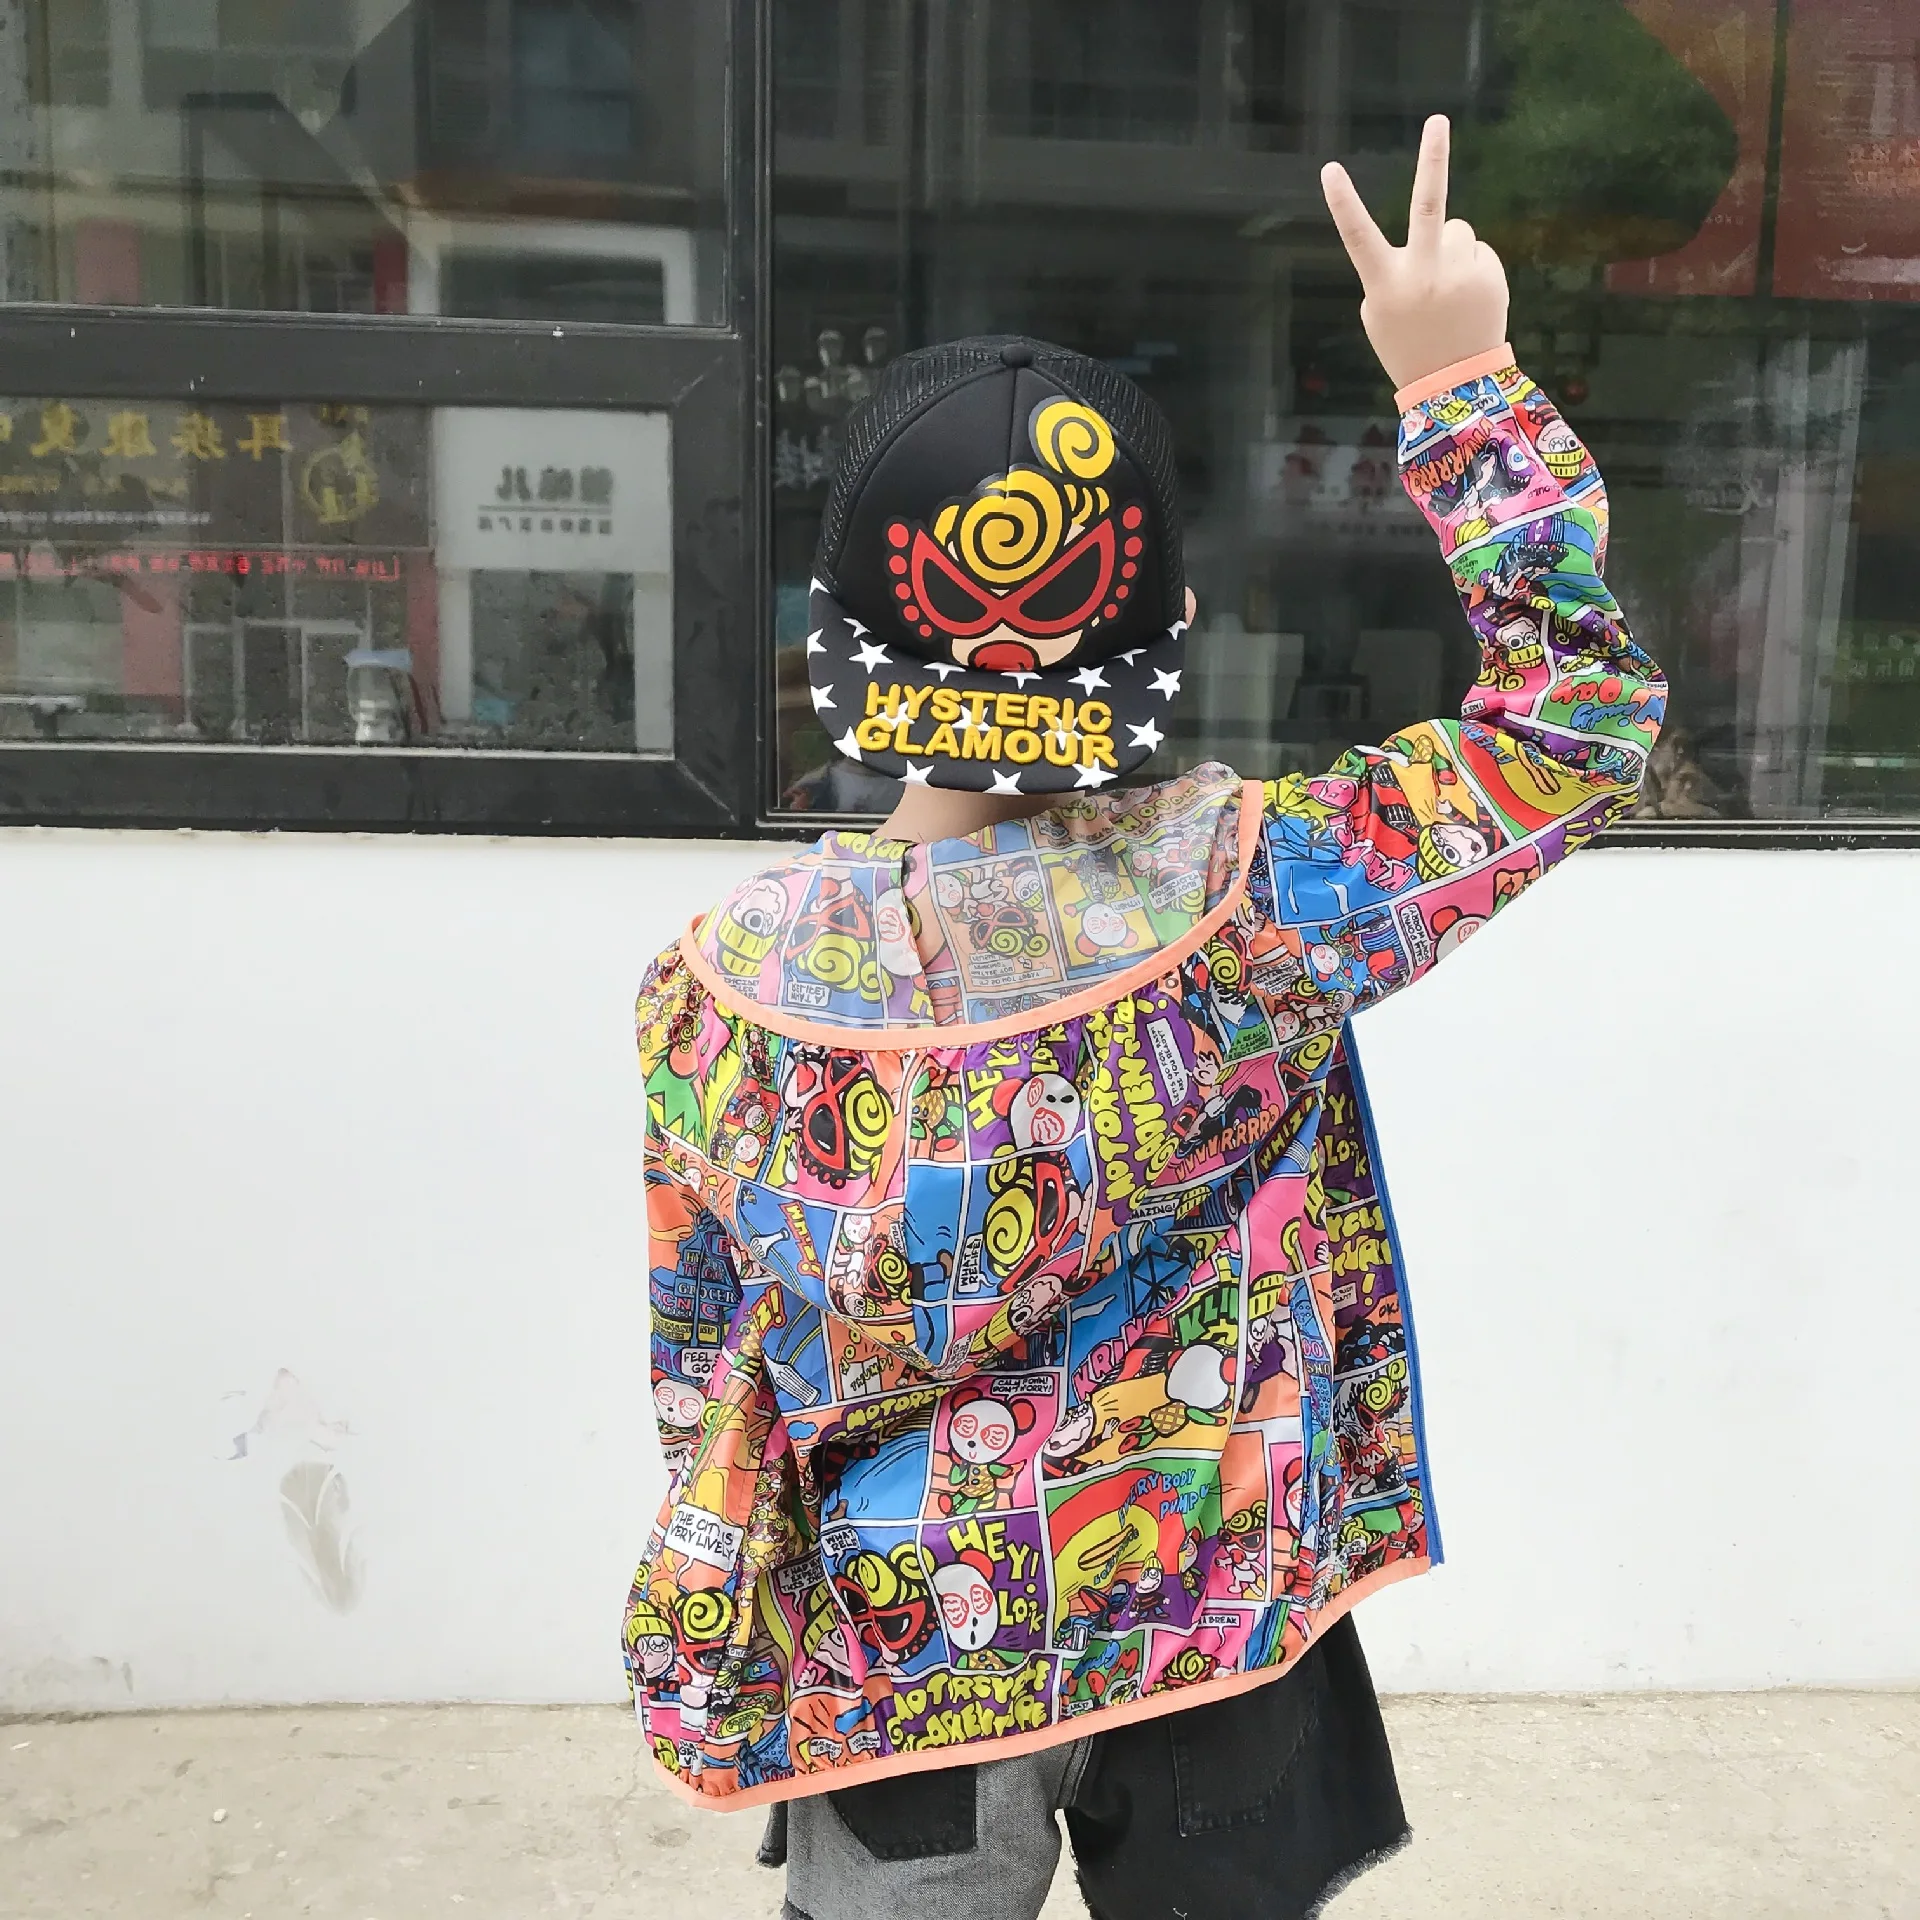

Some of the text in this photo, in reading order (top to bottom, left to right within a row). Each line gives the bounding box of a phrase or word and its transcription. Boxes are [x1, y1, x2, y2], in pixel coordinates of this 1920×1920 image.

[865, 681, 1112, 733] HYSTERIC
[855, 717, 1119, 768] GLAMOUR
[960, 1251, 970, 1287] WHAT
[684, 1352, 711, 1364] FEEL
[675, 1510, 694, 1528] THE
[1160, 1492, 1198, 1520] PUMP
[670, 1523, 735, 1560] VERY LIVELY
[948, 1521, 1040, 1594] HEY!
[1208, 1616, 1237, 1625] BREAK
